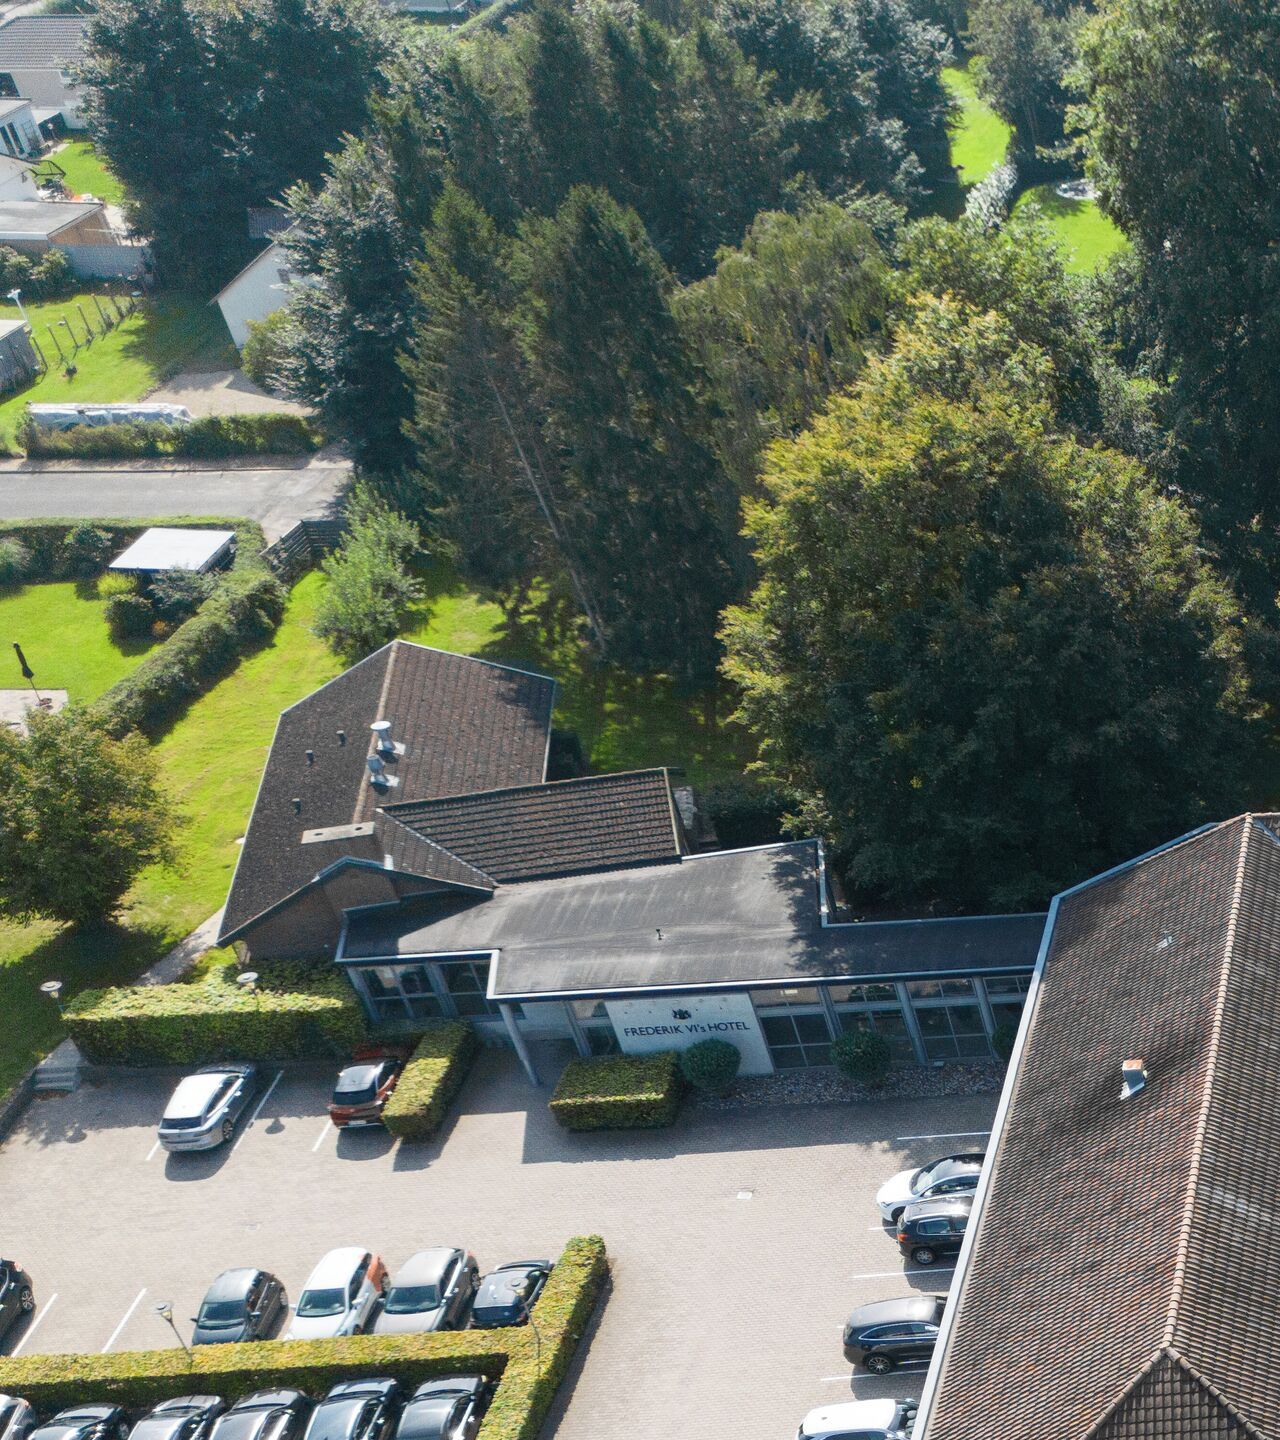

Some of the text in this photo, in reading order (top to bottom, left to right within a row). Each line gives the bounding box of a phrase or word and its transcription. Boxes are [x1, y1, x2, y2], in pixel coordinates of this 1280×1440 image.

[623, 1021, 750, 1036] FREDERIK VI's HOTEL
